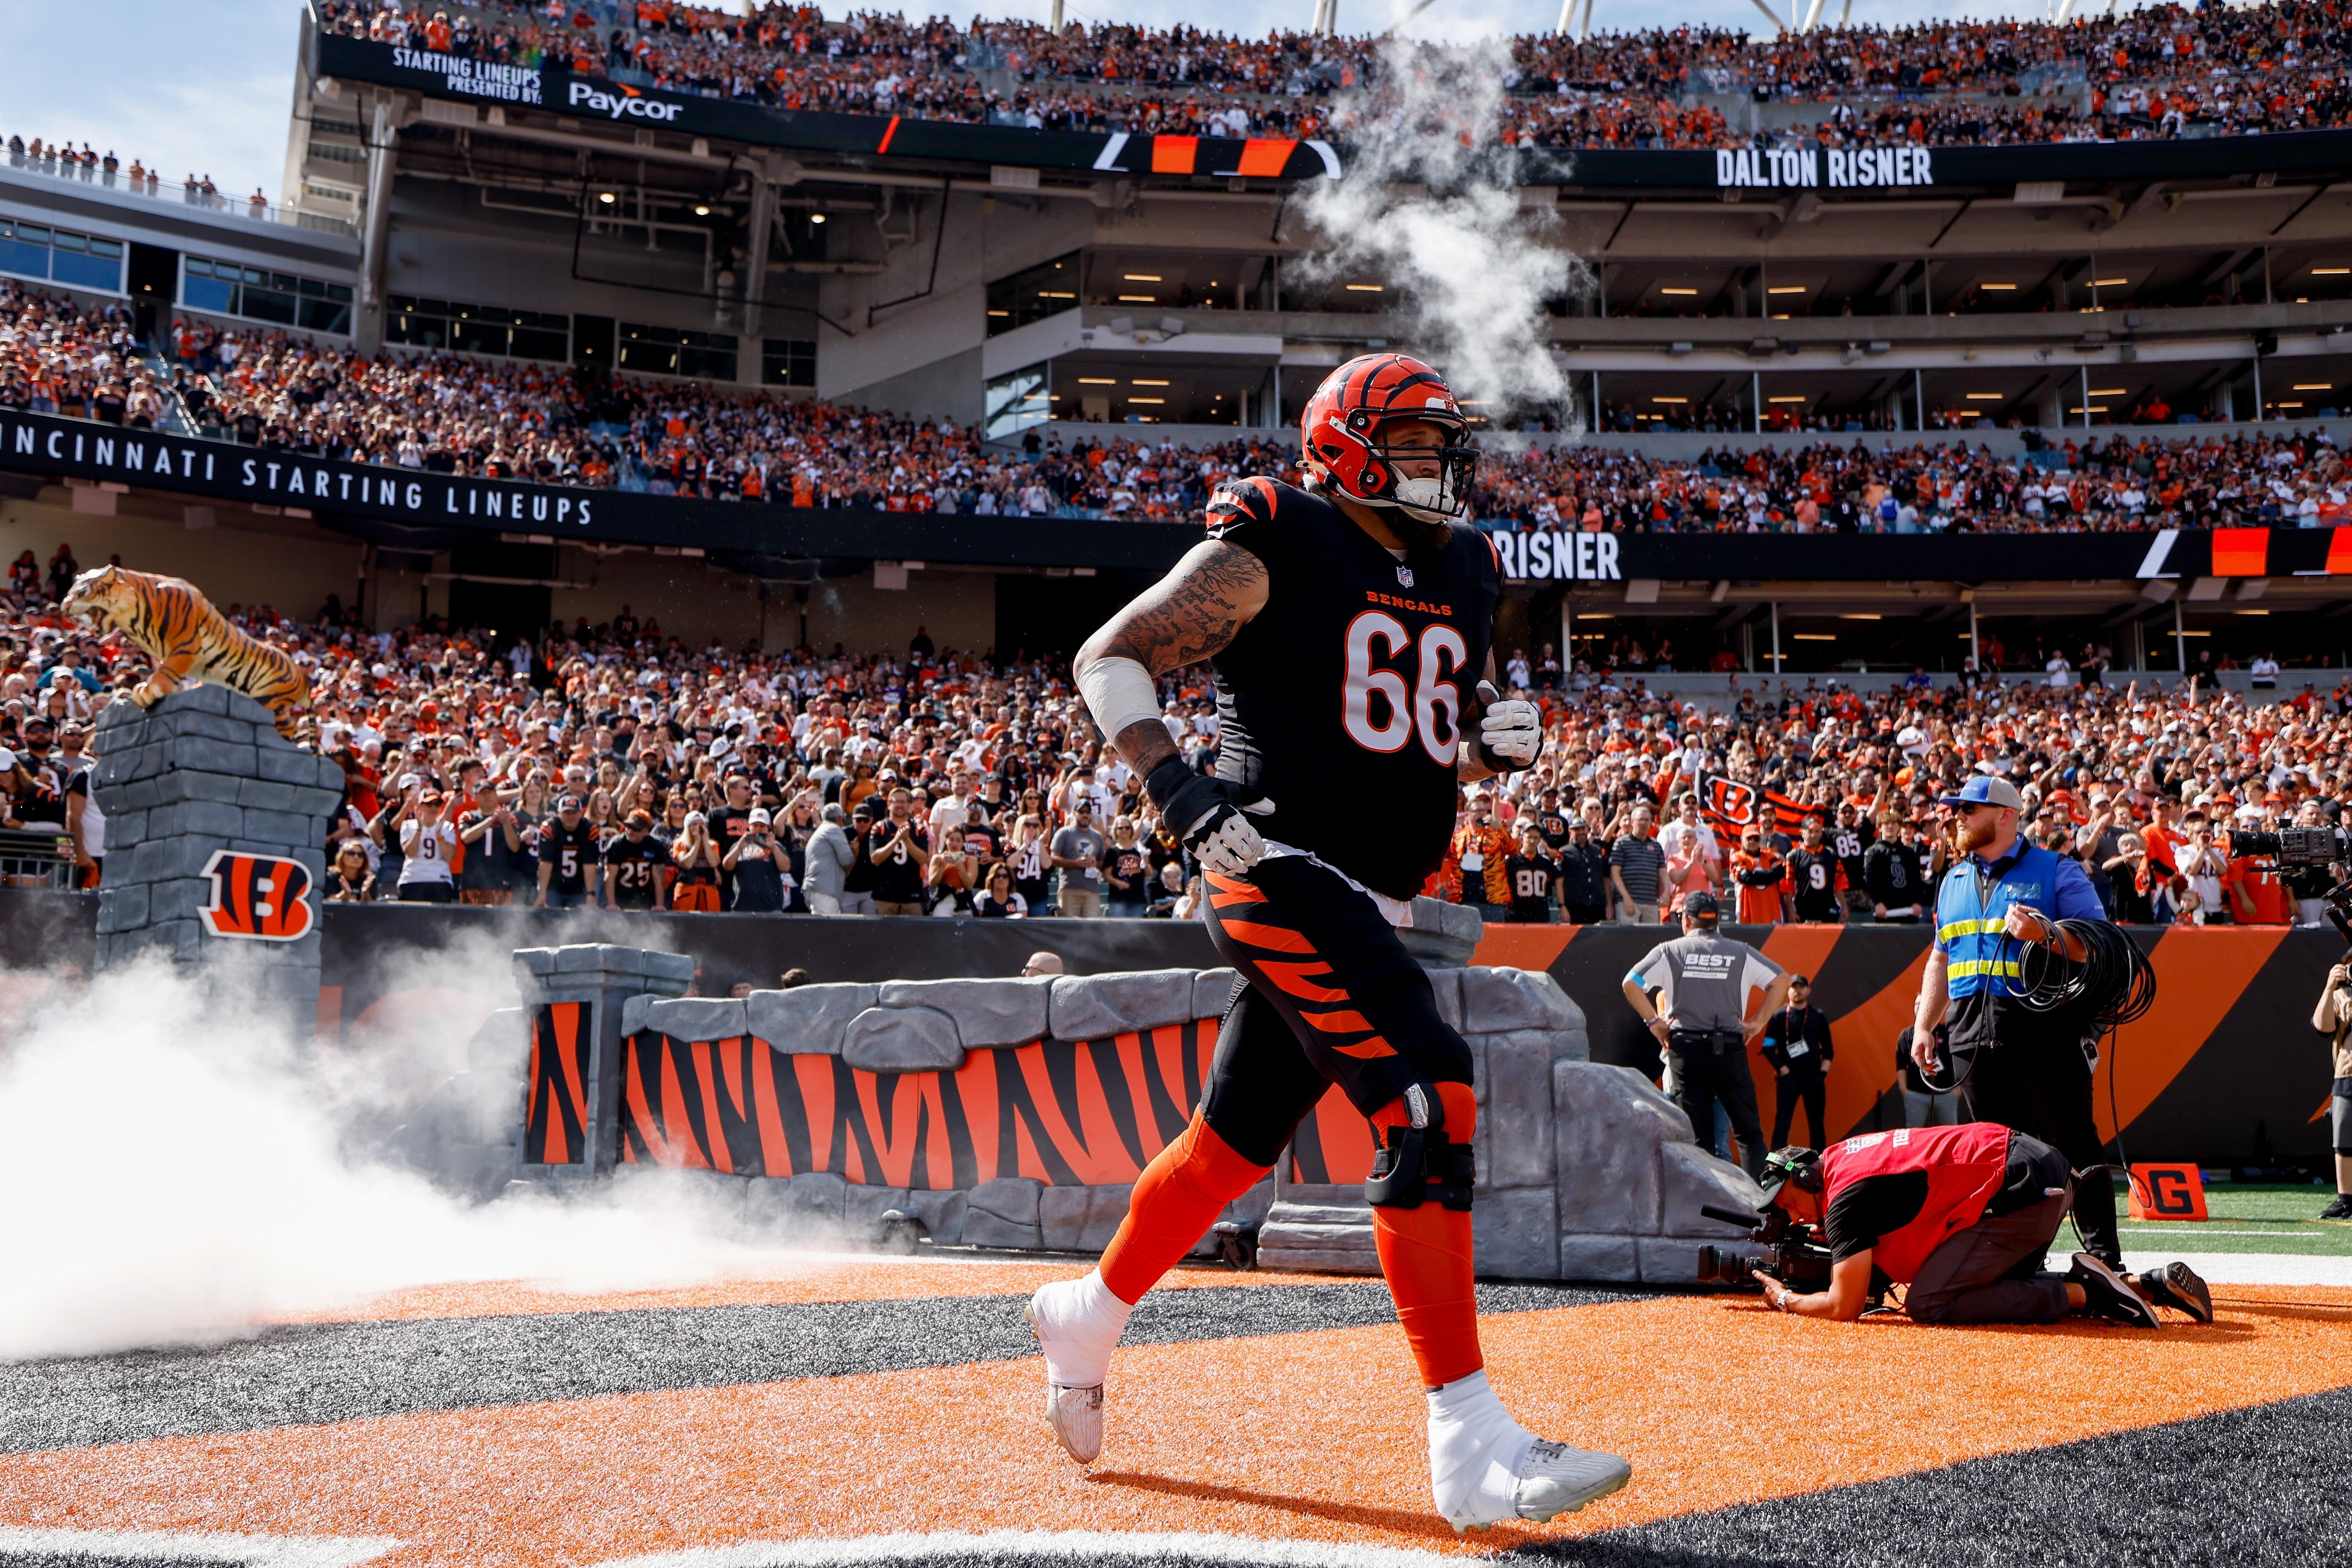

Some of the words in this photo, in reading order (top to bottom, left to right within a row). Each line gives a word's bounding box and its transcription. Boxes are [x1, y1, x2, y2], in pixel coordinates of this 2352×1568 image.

[393, 47, 471, 77] STARTING
[476, 60, 541, 88] LINEUPS
[447, 74, 520, 101] PRESENTED
[522, 86, 543, 105] BY:
[569, 82, 683, 121] Paycor
[1717, 149, 1818, 187] DALTON
[1828, 147, 1934, 187] RISNER
[0, 425, 214, 481] NCINNATI
[242, 459, 422, 509] STARTING
[447, 487, 591, 525] LINEUPS
[1492, 530, 1622, 580] RISNER
[1400, 574, 1411, 584] NFL
[1193, 605, 1219, 623] comfort
[1209, 597, 1237, 610] great
[1366, 591, 1452, 616] BENGALS
[1342, 609, 1467, 767] 66
[1037, 773, 1051, 794] 14
[423, 838, 435, 859] 9
[484, 827, 492, 856] 1
[893, 839, 908, 865] 9
[1835, 833, 1861, 858] 85
[561, 850, 577, 878] 5
[619, 861, 650, 888] 25
[1016, 855, 1042, 880] 94
[1809, 864, 1826, 889] 9
[1890, 862, 1906, 889] 9
[1516, 870, 1547, 897] 80
[1685, 953, 1736, 967] BEST
[2148, 1170, 2195, 1215] G
